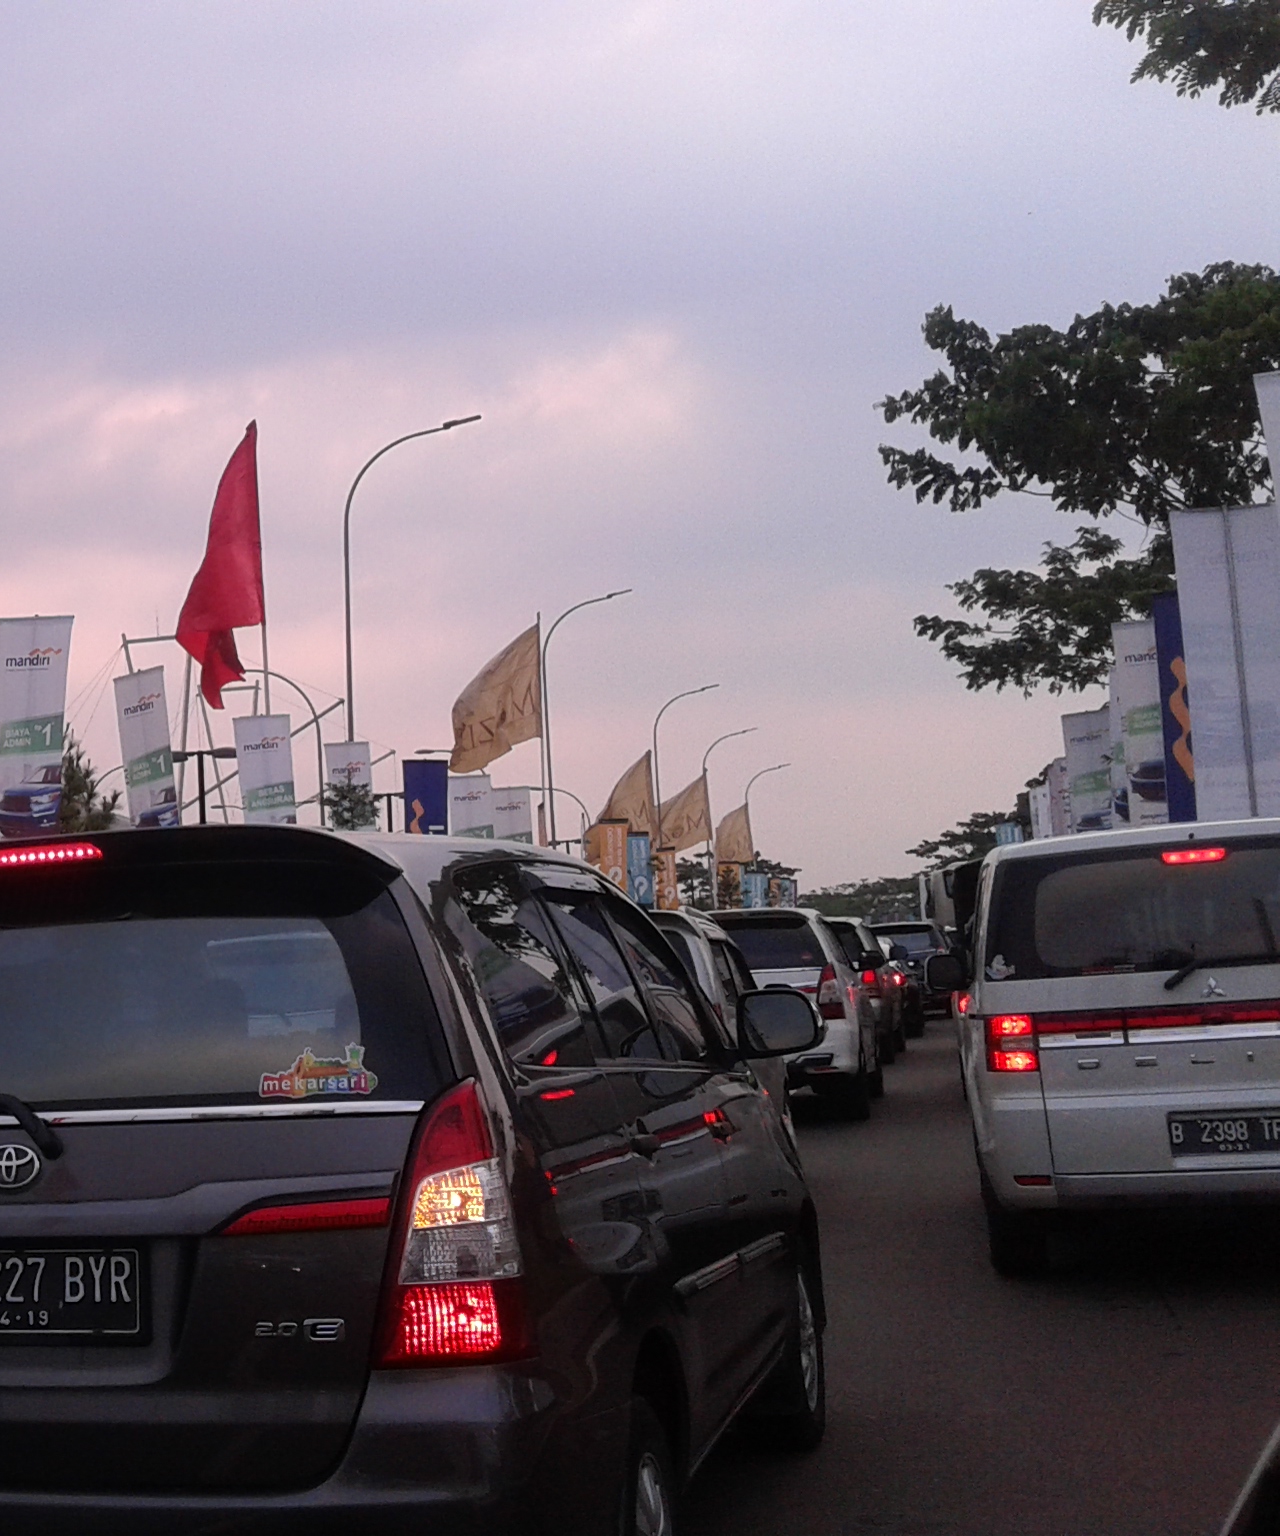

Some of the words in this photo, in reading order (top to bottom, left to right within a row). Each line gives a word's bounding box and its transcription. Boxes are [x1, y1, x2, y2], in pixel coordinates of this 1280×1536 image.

[5, 655, 50, 668] mandiri
[123, 701, 154, 716] mandiri
[243, 740, 278, 752] mandiri
[332, 765, 361, 774] mandiri
[454, 794, 481, 802] mandiri
[263, 1072, 365, 1091] mekarsari
[1171, 1122, 1184, 1144] B
[1200, 1120, 1249, 1142] 2398
[64, 1256, 132, 1303] BYR
[255, 1321, 298, 1336] 2.0
